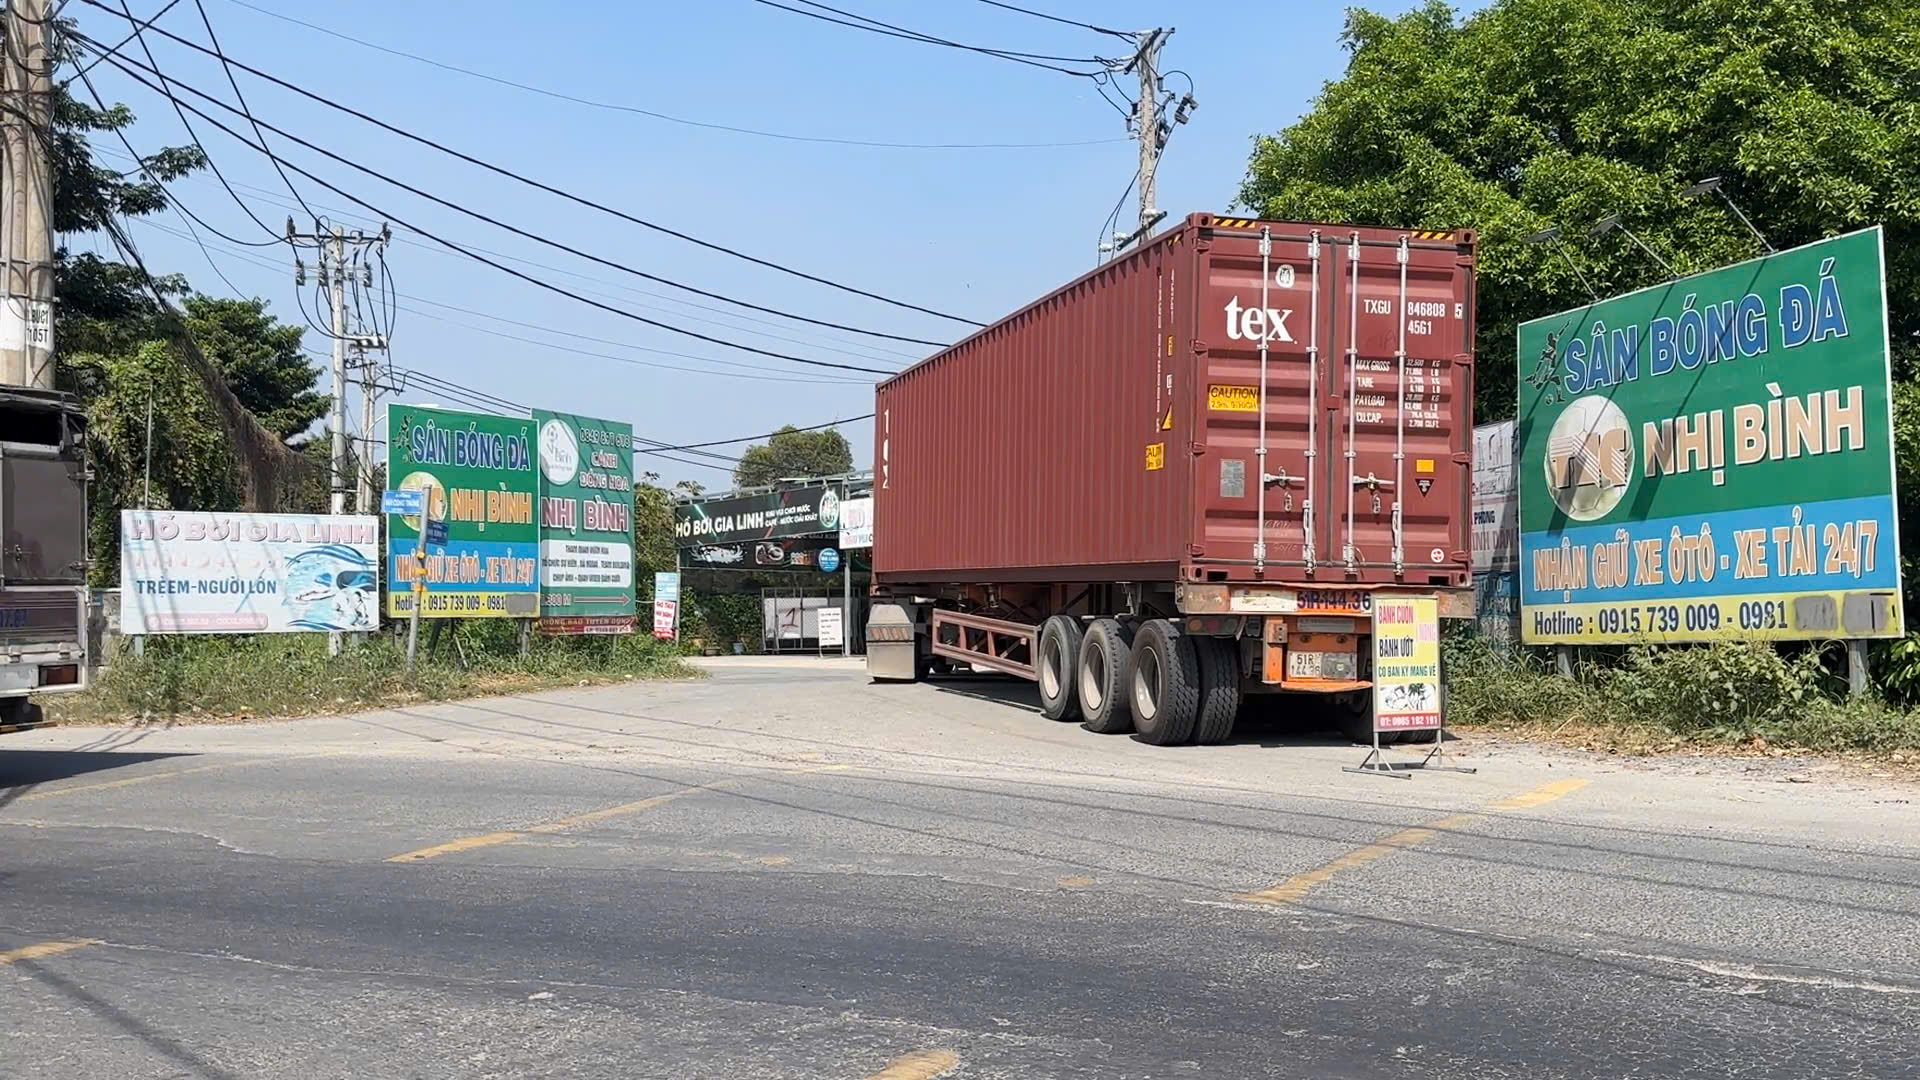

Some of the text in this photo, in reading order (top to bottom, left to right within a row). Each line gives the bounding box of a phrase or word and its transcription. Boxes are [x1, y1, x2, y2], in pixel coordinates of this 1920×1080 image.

[1364, 299, 1463, 319] TXGU 846808 5
[1408, 320, 1432, 335] 45G1
[1564, 256, 1848, 394] SÂN BÓNG ĐÁ
[1211, 387, 1257, 399] CAUTION
[1356, 376, 1374, 388] TARE
[1355, 395, 1385, 407] PAYLOAD
[412, 419, 450, 465] SÂN
[455, 422, 504, 469] BÓNG
[508, 427, 531, 472] ĐÁ
[1643, 382, 1865, 486] NHỊ BÌNH
[450, 482, 532, 531] NHỊ BÌNH
[541, 494, 629, 536] NHỊ BÌNH
[184, 519, 240, 542] BƠI
[248, 521, 303, 543] GIA
[306, 522, 375, 544] LINH
[693, 515, 713, 536] BƠI
[714, 516, 735, 533] GIA
[736, 511, 764, 531] LINH
[444, 555, 459, 583] XE
[459, 550, 480, 584] ÔTÔ
[485, 556, 501, 583] XE
[500, 548, 517, 584] TẢI
[1533, 537, 1588, 603] NHẬN
[1592, 528, 1630, 589] GIỮ
[1633, 538, 1664, 587] XE
[1668, 522, 1716, 585] ÔTÔ
[1734, 528, 1768, 579] XE
[1771, 505, 1817, 577] TẢI
[1823, 520, 1878, 579] 24/7
[395, 595, 413, 610] Hotli
[428, 595, 448, 610] 0915
[450, 595, 465, 610] 739
[466, 596, 480, 610] 009
[487, 595, 505, 611] 0981
[1533, 611, 1584, 636] Hotline
[1599, 606, 1641, 633] 0915
[1646, 606, 1679, 633] 739
[1685, 603, 1719, 631] 009
[1740, 600, 1788, 629] 0981
[1297, 654, 1314, 665] 51R
[1410, 666, 1428, 676] MANG
